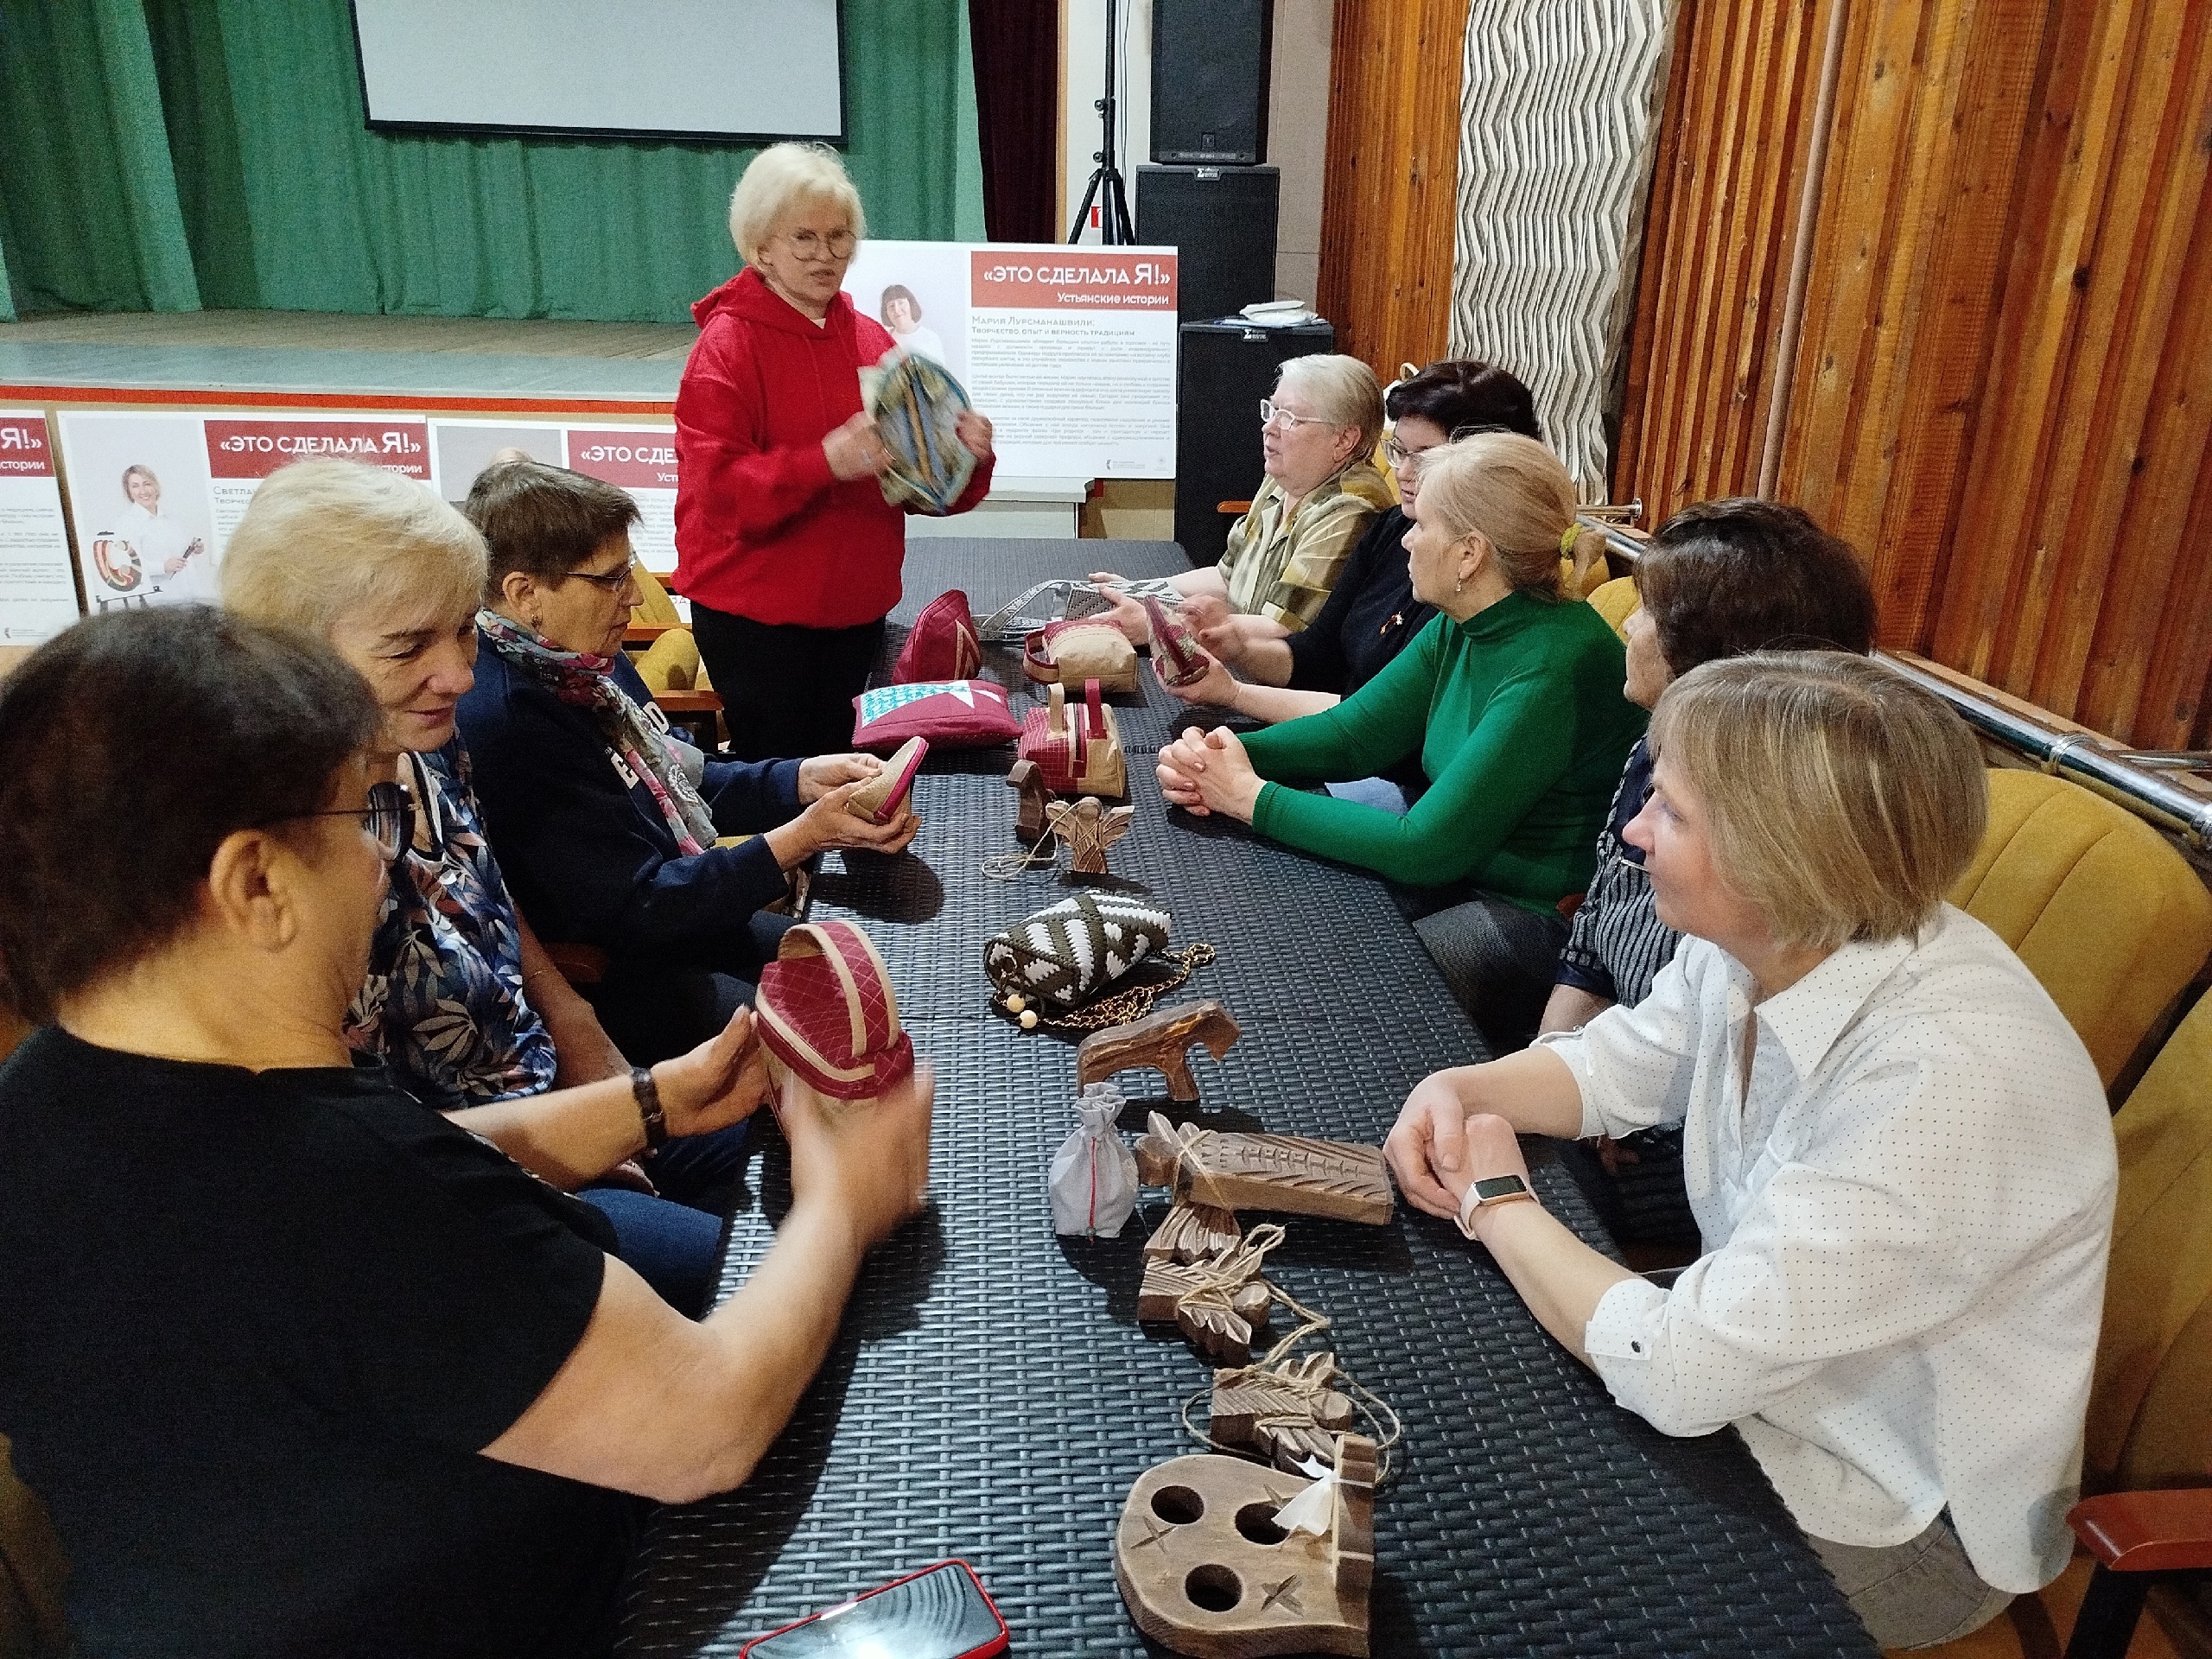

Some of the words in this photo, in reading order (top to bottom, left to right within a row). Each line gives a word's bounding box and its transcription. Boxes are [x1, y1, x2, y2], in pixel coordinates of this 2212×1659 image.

[983, 265, 1033, 283] «ЭТО
[1036, 267, 1130, 286] СДЕЛАЛА
[1134, 263, 1171, 286] Я!»
[1057, 292, 1121, 304] Устьянские
[1122, 294, 1169, 307] истории
[0, 428, 42, 449] Я!»
[219, 435, 274, 453] «ЭТО
[276, 436, 378, 454] СДЕЛАЛА
[381, 431, 422, 454] Я!»
[581, 445, 632, 462] «ЭТО
[0, 461, 45, 472] стории
